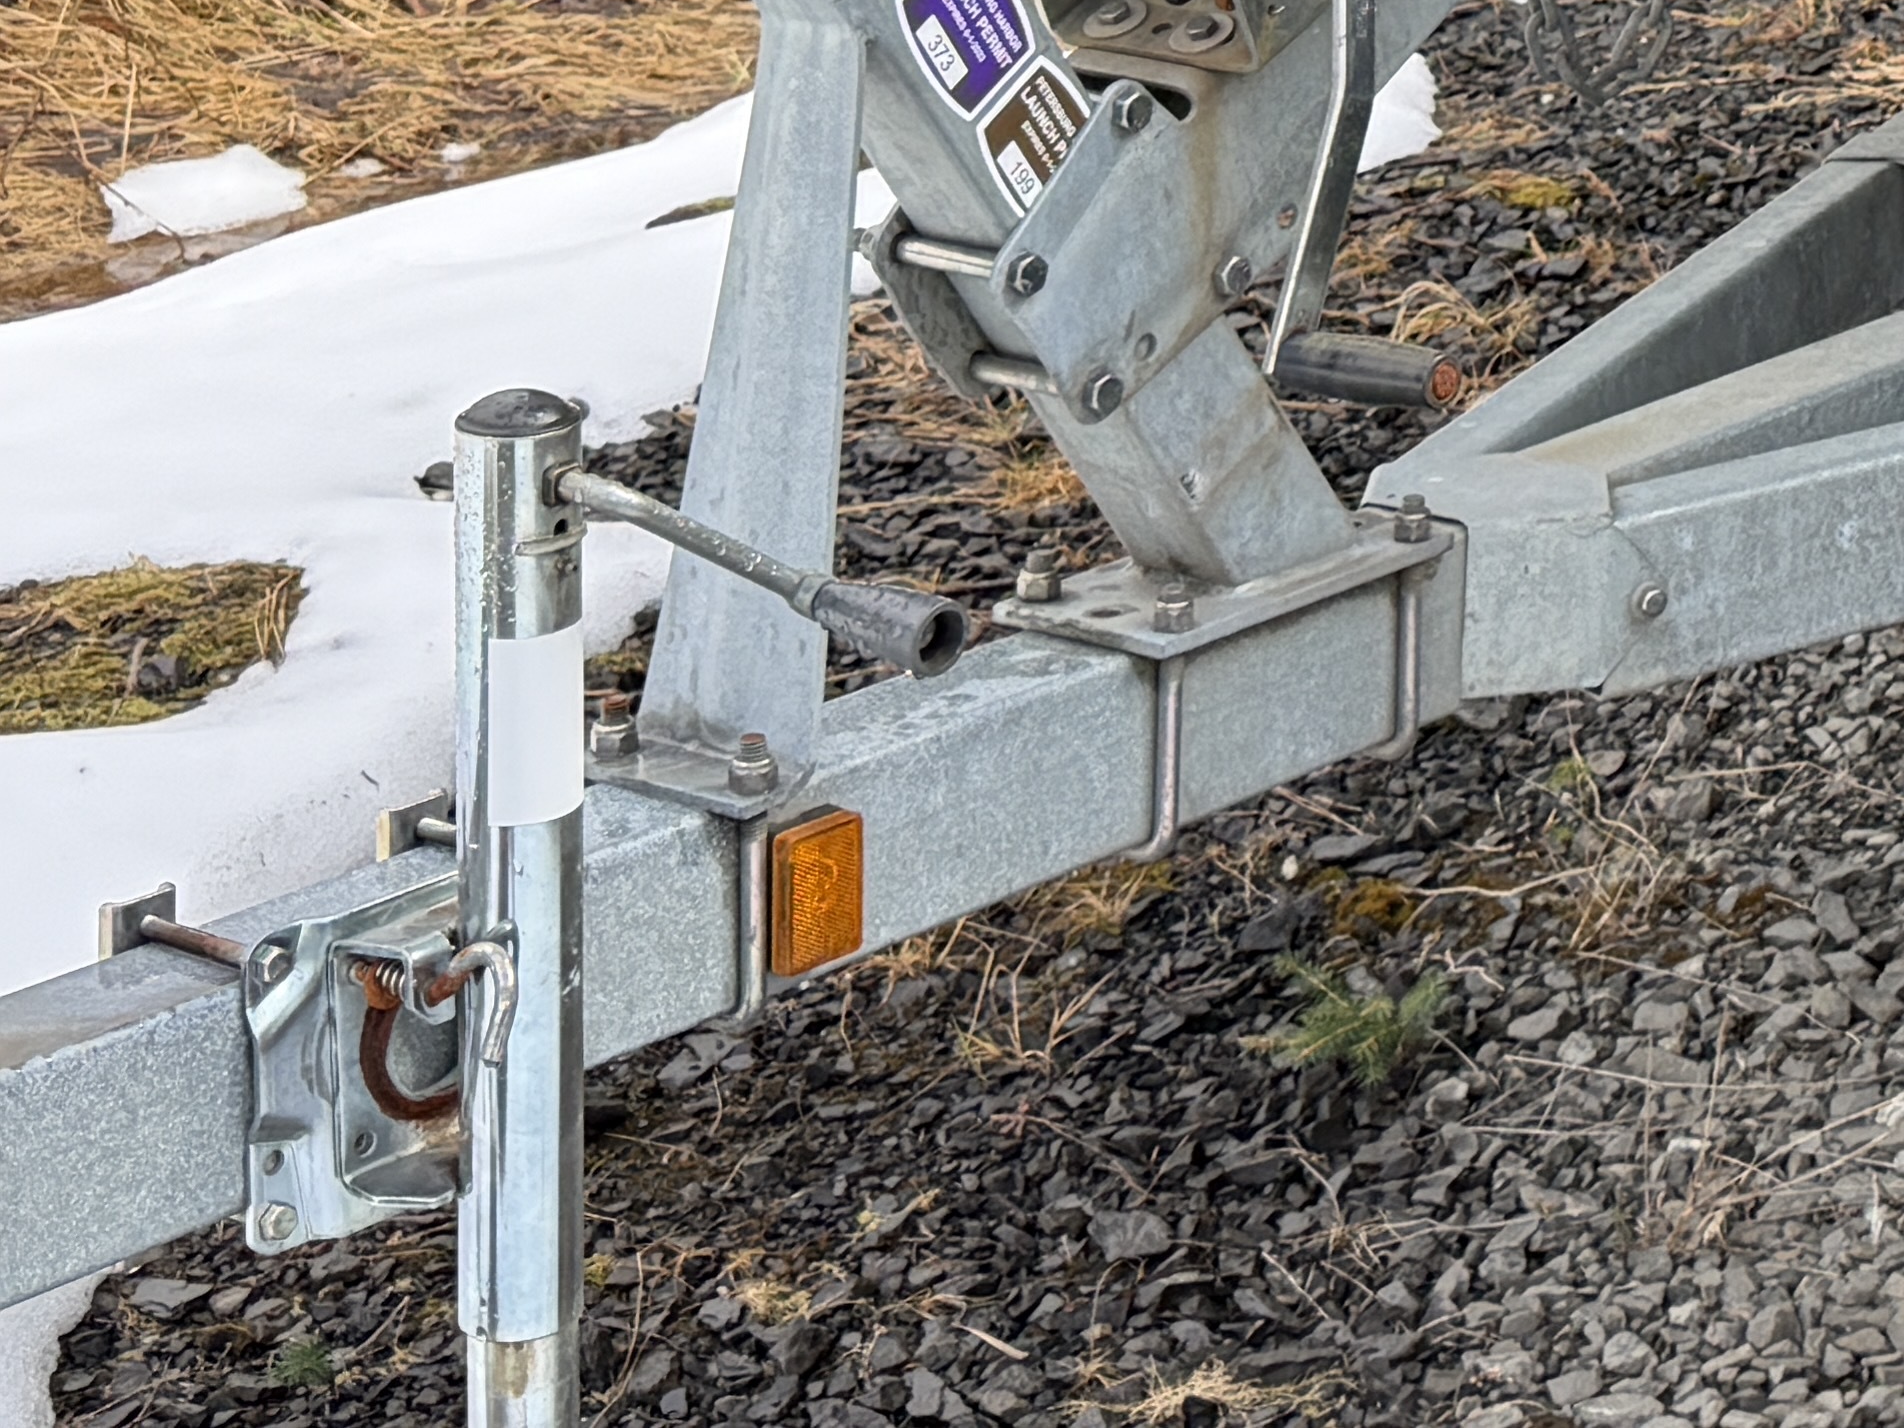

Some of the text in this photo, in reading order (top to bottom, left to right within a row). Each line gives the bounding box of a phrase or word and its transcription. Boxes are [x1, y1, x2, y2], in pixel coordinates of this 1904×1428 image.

[925, 33, 957, 73] 373
[974, 14, 1013, 69] PERMIT
[992, 10, 1023, 53] HARBOR
[1019, 85, 1061, 144] LAUNCH
[1034, 74, 1077, 138] PETERSBURG
[1007, 159, 1037, 196] 199
